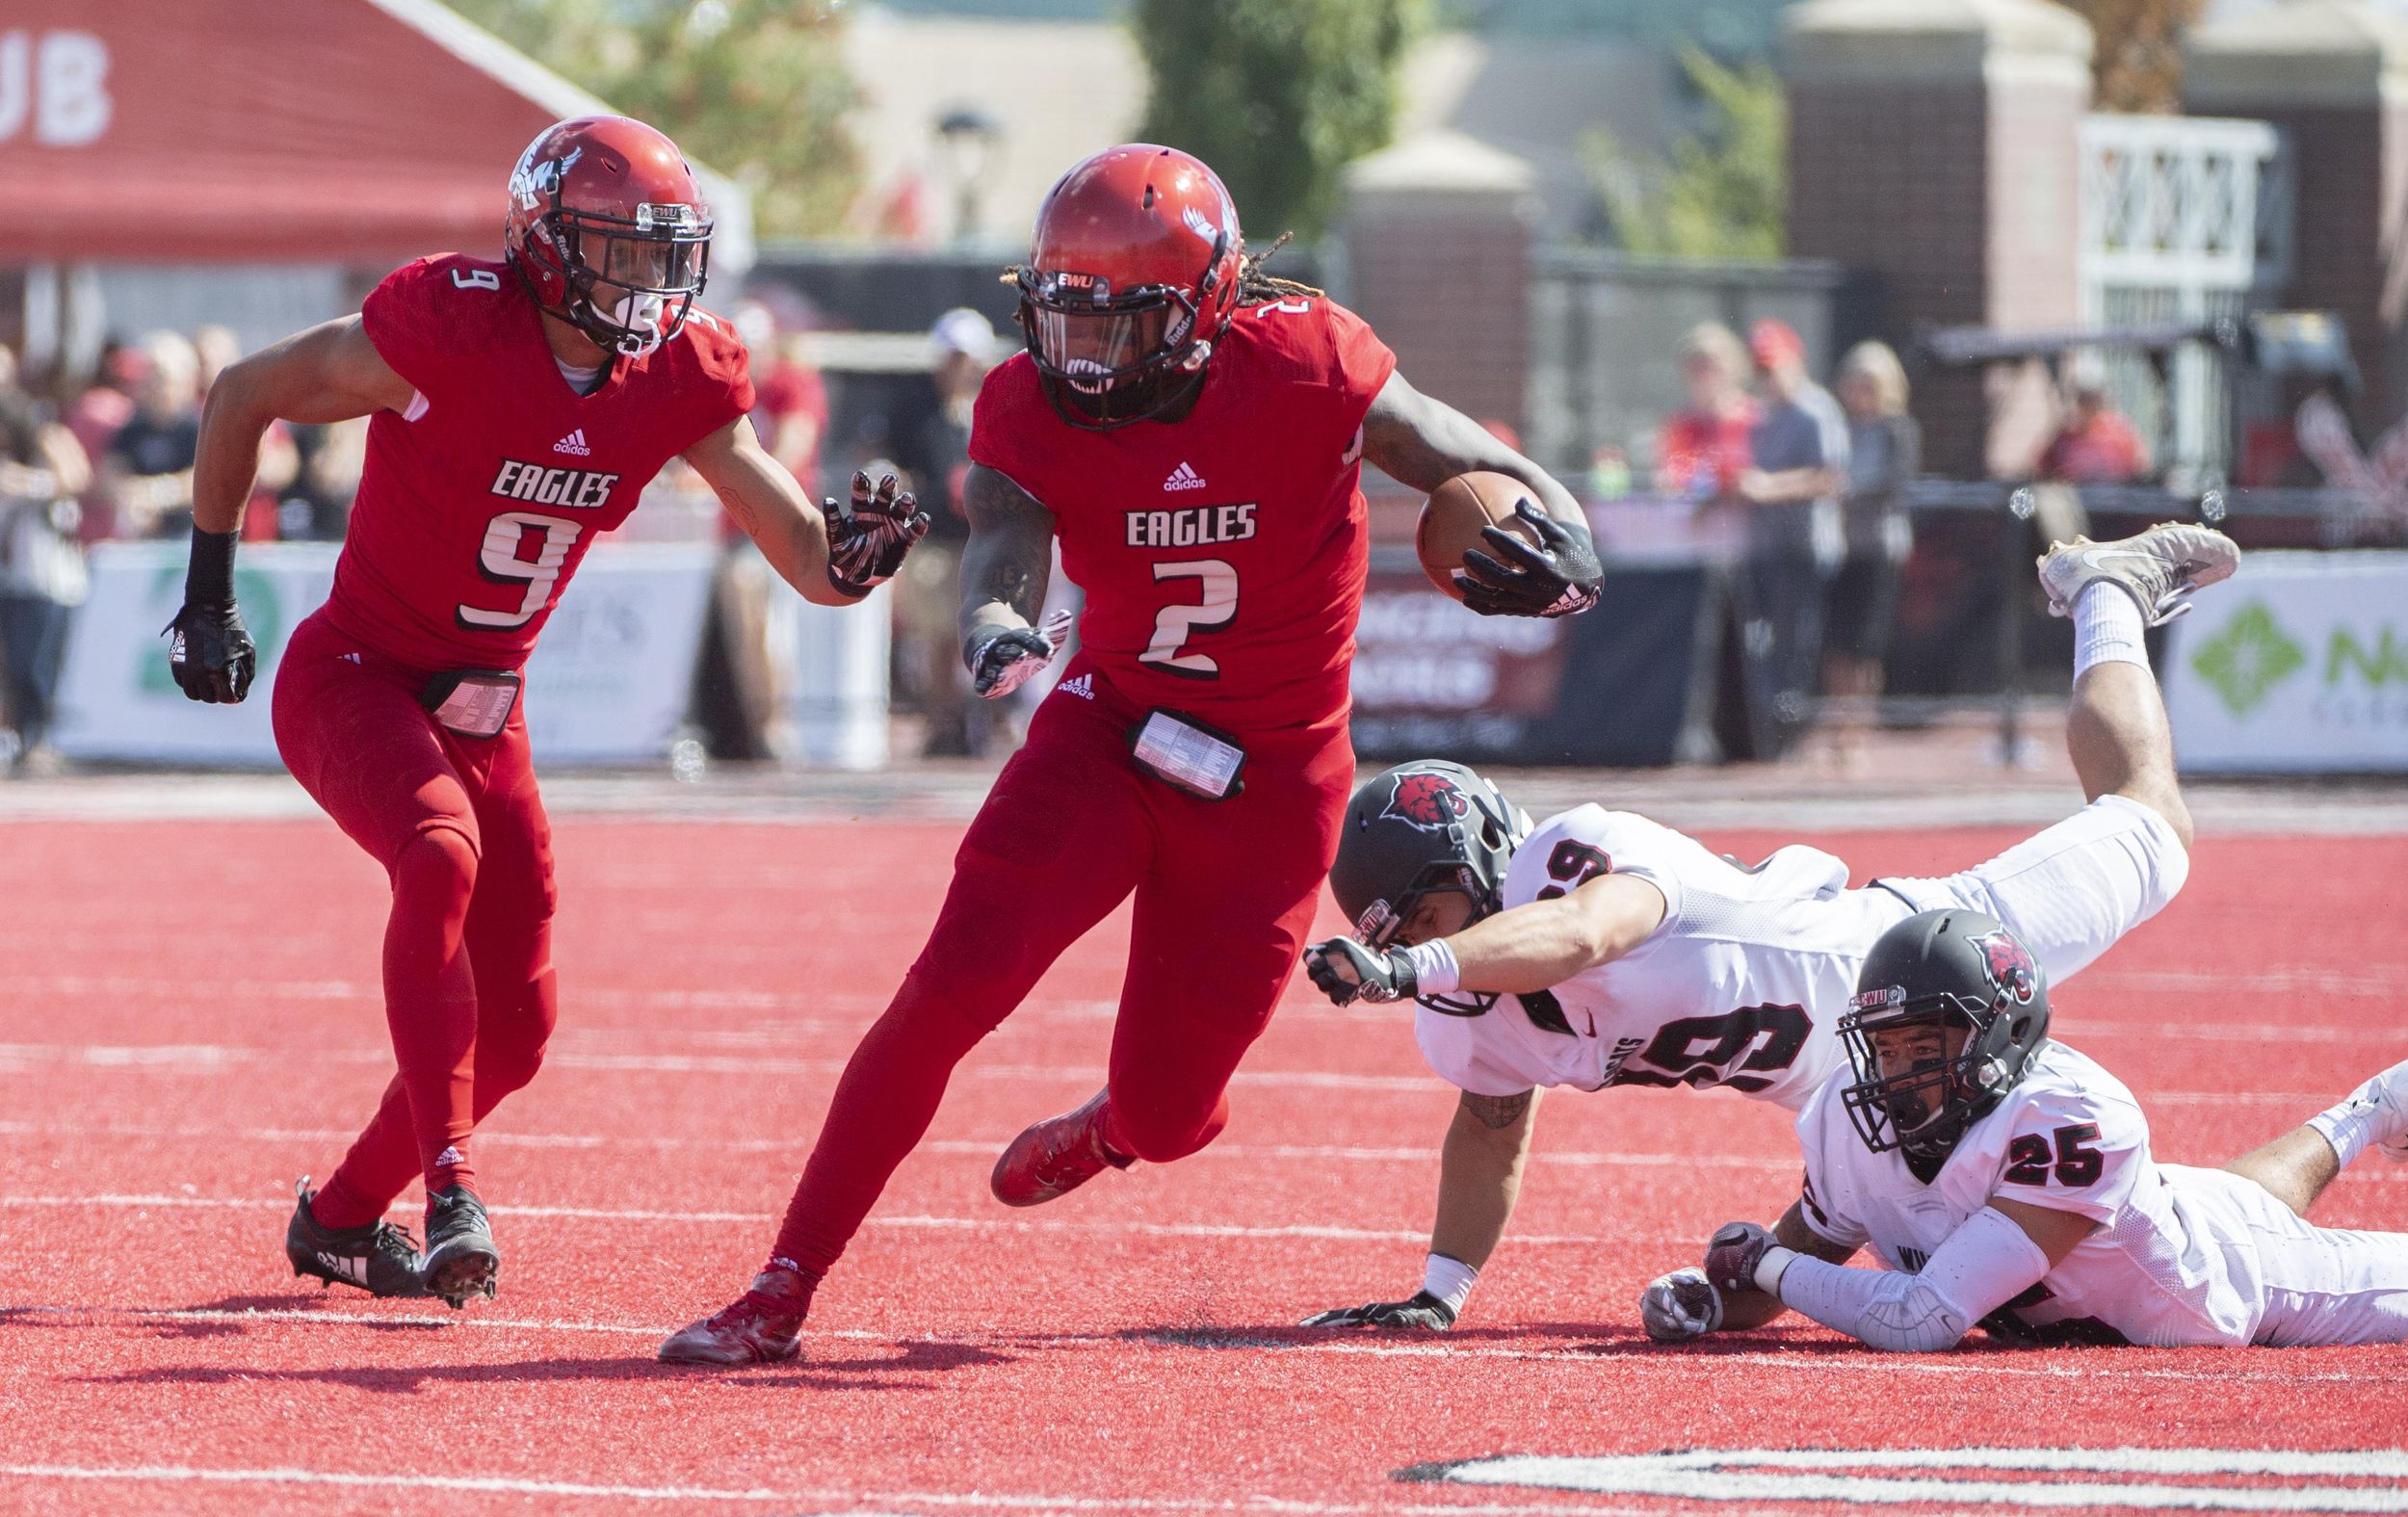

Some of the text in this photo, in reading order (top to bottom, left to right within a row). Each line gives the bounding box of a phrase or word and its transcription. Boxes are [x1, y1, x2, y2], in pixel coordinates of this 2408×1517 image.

[652, 207, 677, 217] EWU
[451, 268, 500, 291] 9
[1058, 273, 1095, 288] EWU
[553, 442, 590, 457] adidas
[489, 458, 621, 509] EAGLES
[1163, 478, 1206, 491] adidas
[1126, 503, 1257, 547] EAGLES
[455, 511, 584, 632] 9
[1138, 559, 1239, 681] 2
[1058, 682, 1095, 701] adidas
[2003, 1122, 2104, 1188] 25
